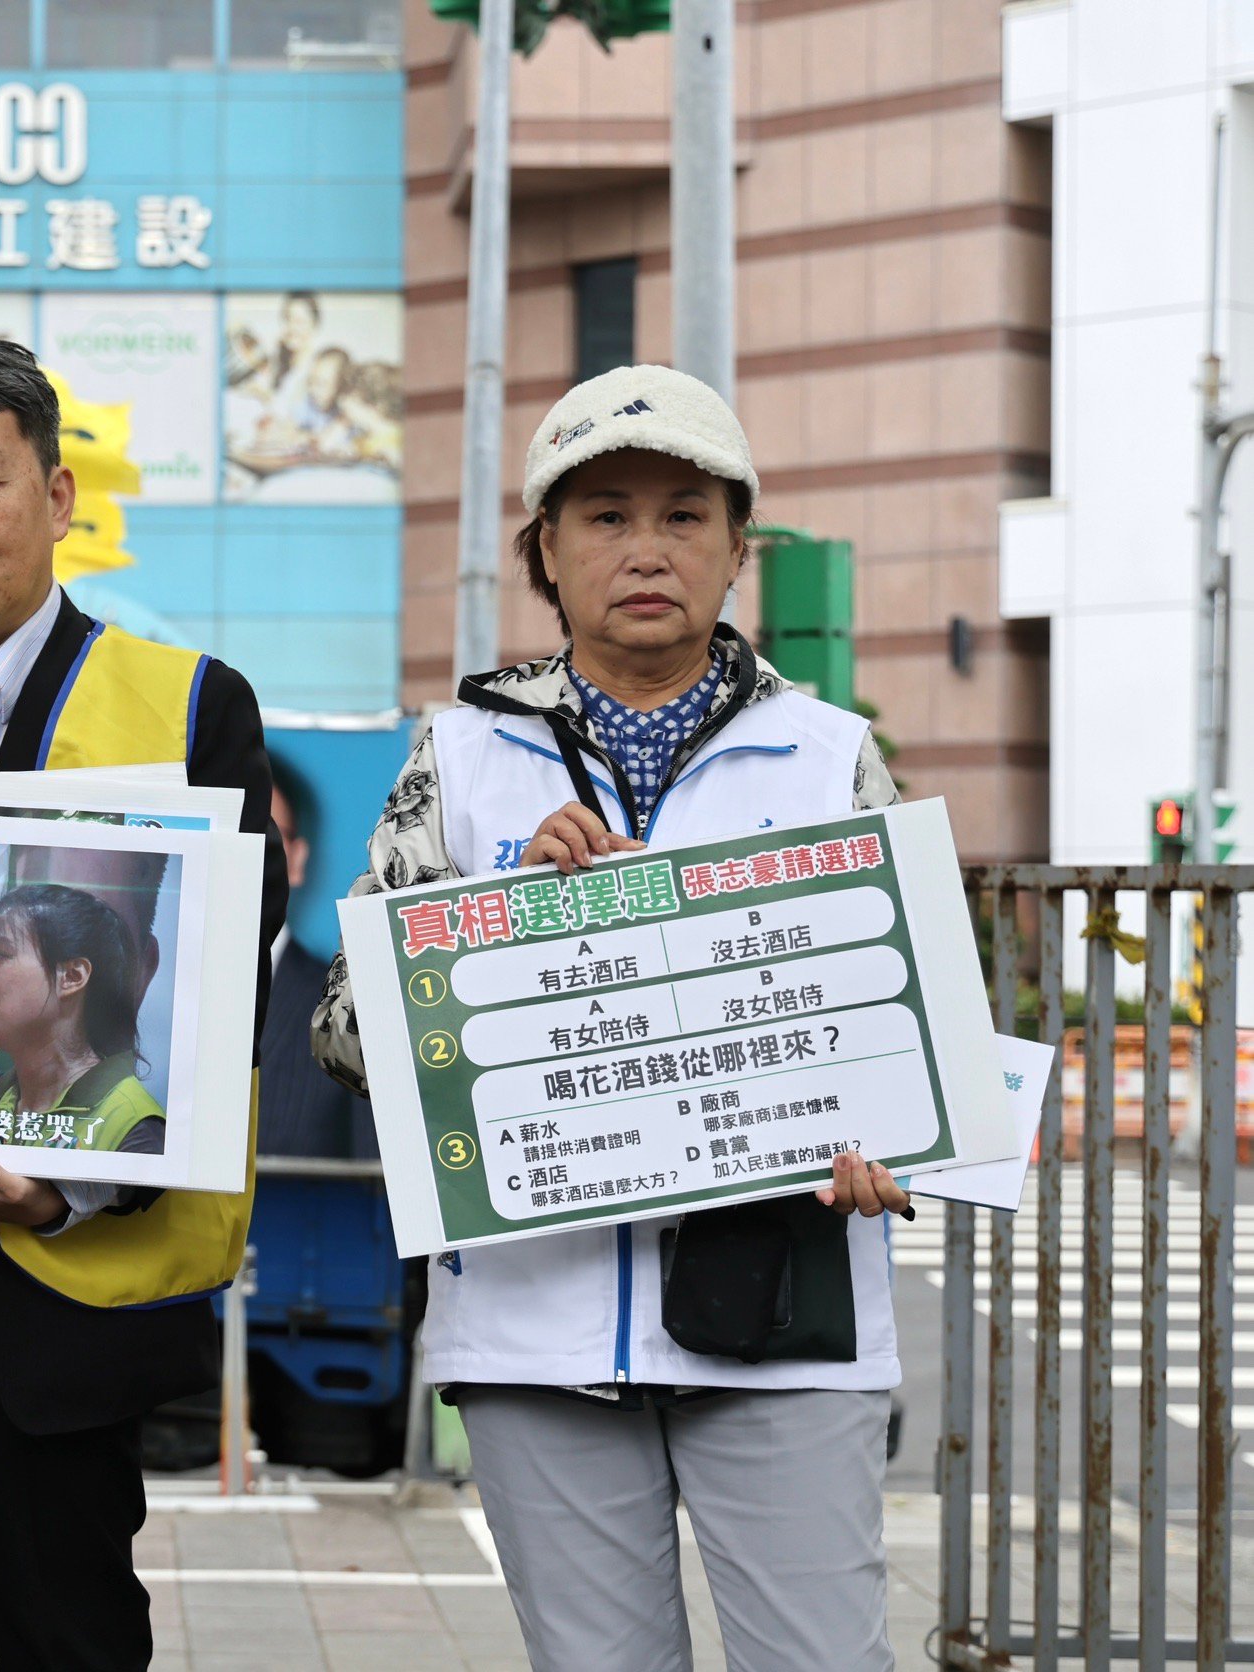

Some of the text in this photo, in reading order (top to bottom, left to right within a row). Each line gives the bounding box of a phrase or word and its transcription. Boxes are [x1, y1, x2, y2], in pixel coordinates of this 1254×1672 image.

[399, 832, 884, 957] 真相選擇題 張志豪請選擇
[749, 911, 762, 926] B
[578, 940, 593, 956] A
[711, 924, 813, 963] 沒去酒店
[538, 956, 639, 993] 有去酒店
[760, 970, 773, 985] B
[588, 1000, 604, 1015] A
[722, 983, 824, 1022] 沒女陪侍
[548, 1014, 650, 1052] 有女陪侍
[543, 1024, 841, 1102] 喝花酒錢從哪裡來？
[677, 1090, 740, 1115] B 廠商
[703, 1095, 841, 1133] 哪家廠商這麼慷慨
[499, 1120, 561, 1145] A 薪水
[523, 1129, 641, 1163] 請提供消費證明
[685, 1135, 751, 1162] D 貴黨
[507, 1164, 568, 1191] C 酒店
[531, 1170, 679, 1208] 哪家酒店這麼大方？
